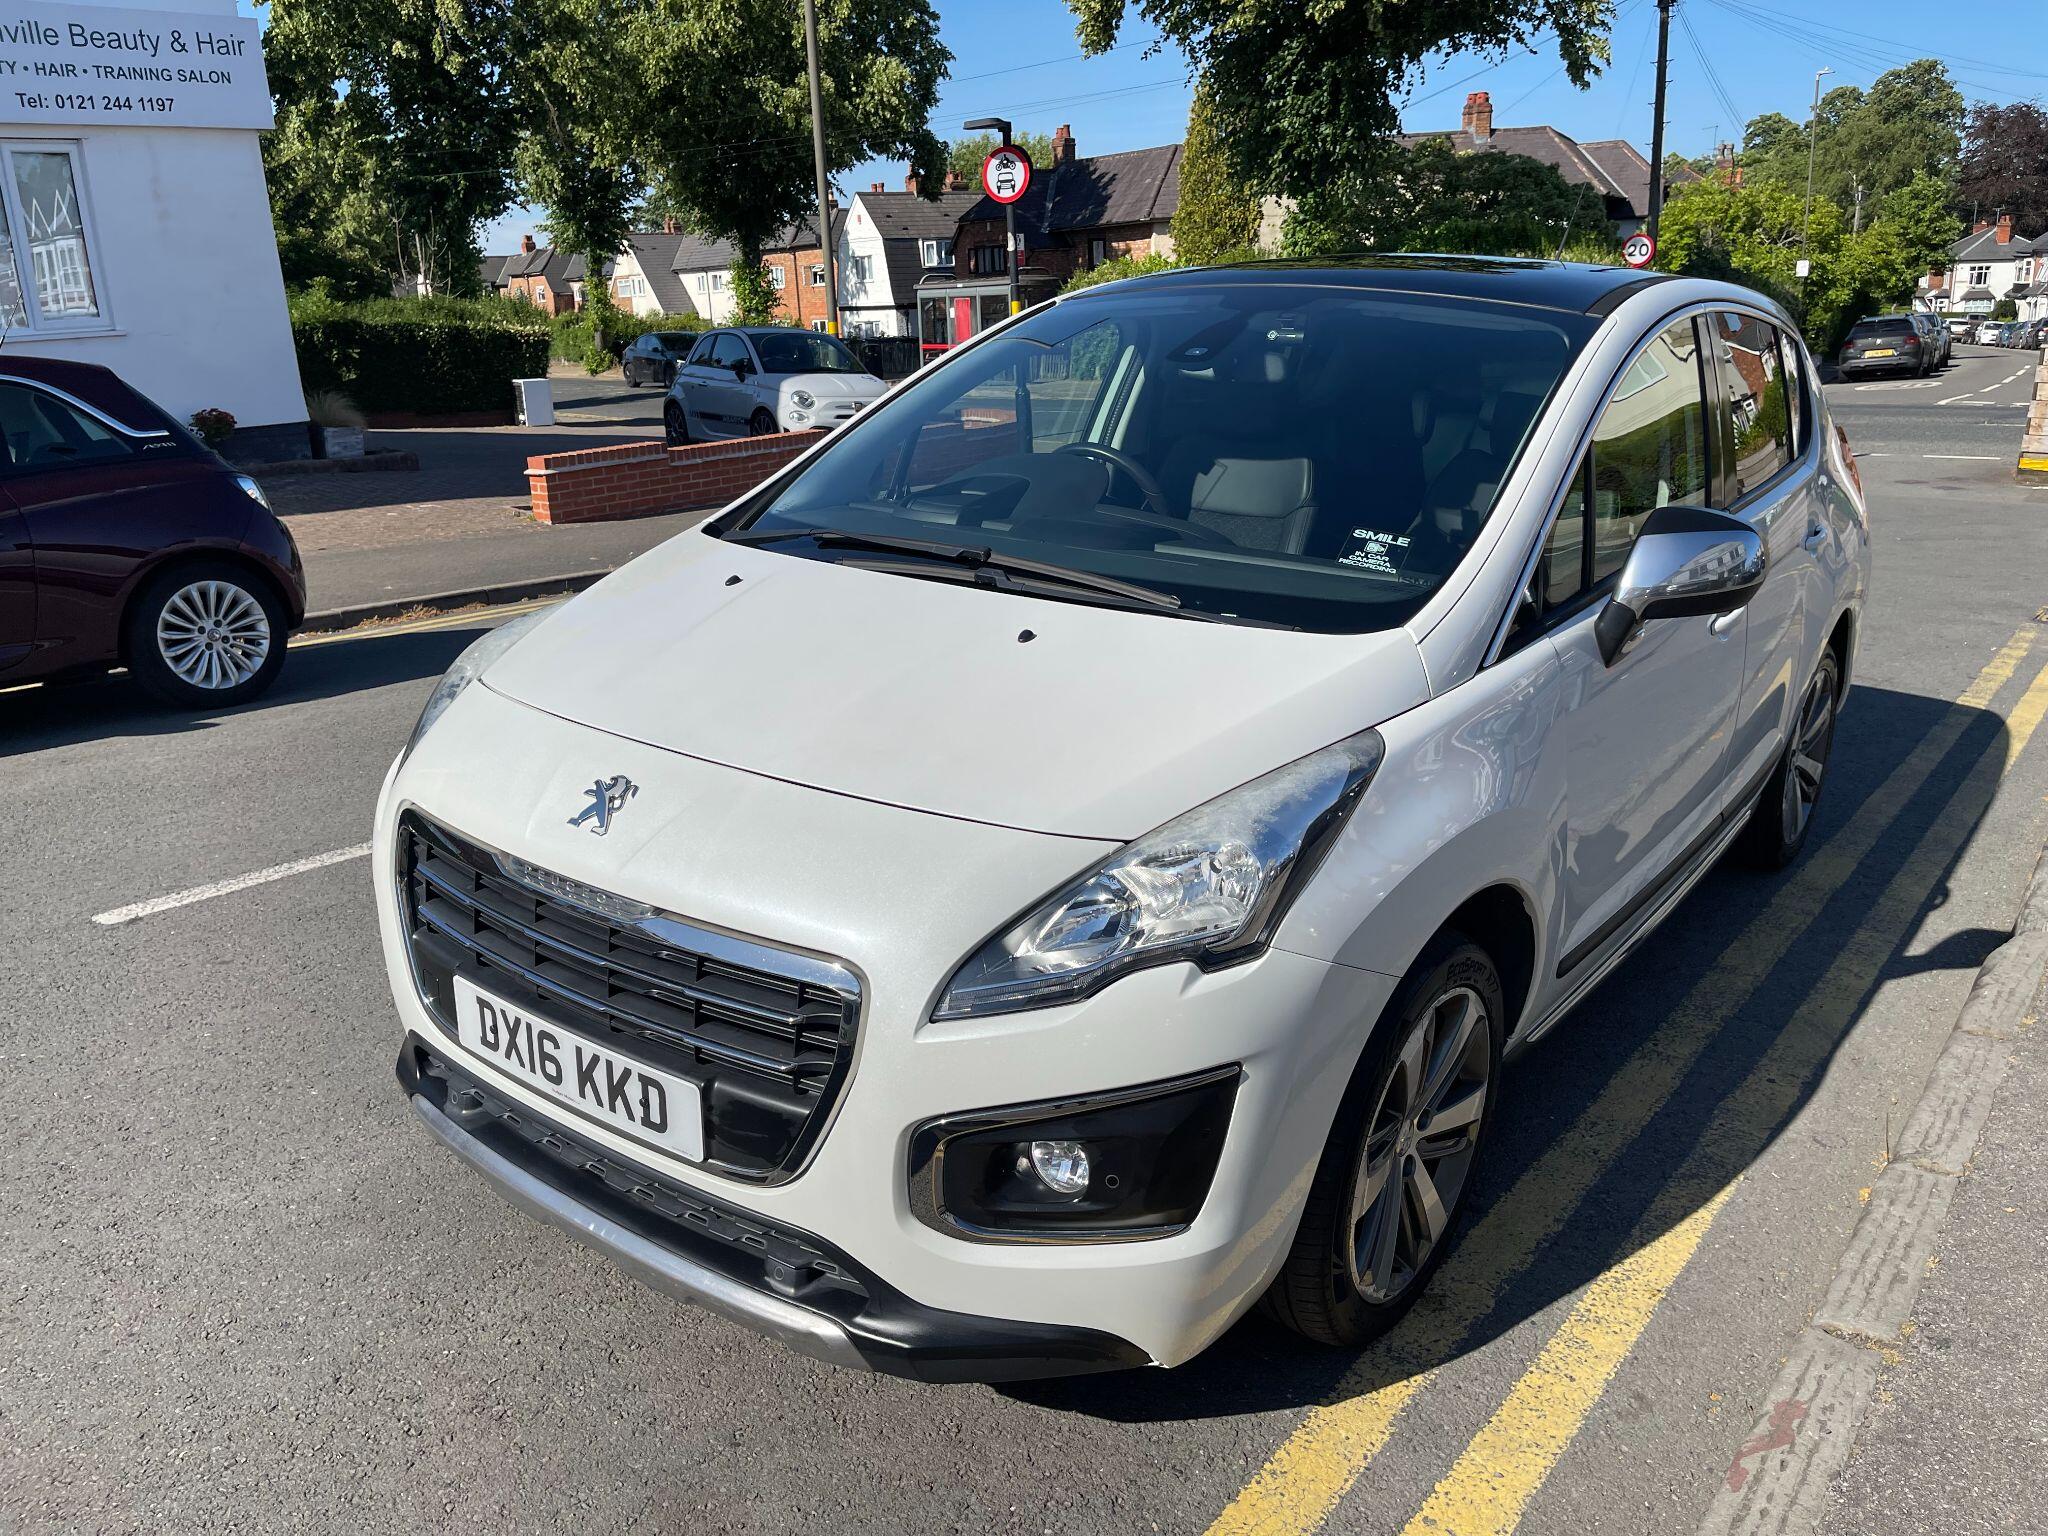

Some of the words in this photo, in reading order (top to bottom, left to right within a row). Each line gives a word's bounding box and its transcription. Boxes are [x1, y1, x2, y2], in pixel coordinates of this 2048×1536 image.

[0, 19, 60, 46] ville
[67, 22, 161, 57] Beauty
[170, 29, 189, 53] &
[195, 31, 246, 57] Hair
[34, 62, 78, 78] HAIR
[92, 65, 173, 82] TRAINING
[177, 69, 232, 84] SALON
[15, 92, 50, 109] Tel:
[55, 94, 96, 110] 0121
[103, 95, 133, 111] 244
[138, 97, 175, 112] 1197
[1627, 243, 1650, 257] 20
[1352, 528, 1411, 547] SMILE
[1338, 557, 1397, 574] RECORDING
[1348, 554, 1391, 568] CAMERA
[1367, 553, 1390, 562] CAR
[524, 864, 623, 908] PEUGEOT
[475, 995, 564, 1087] DX16
[575, 1045, 669, 1135] KKD
